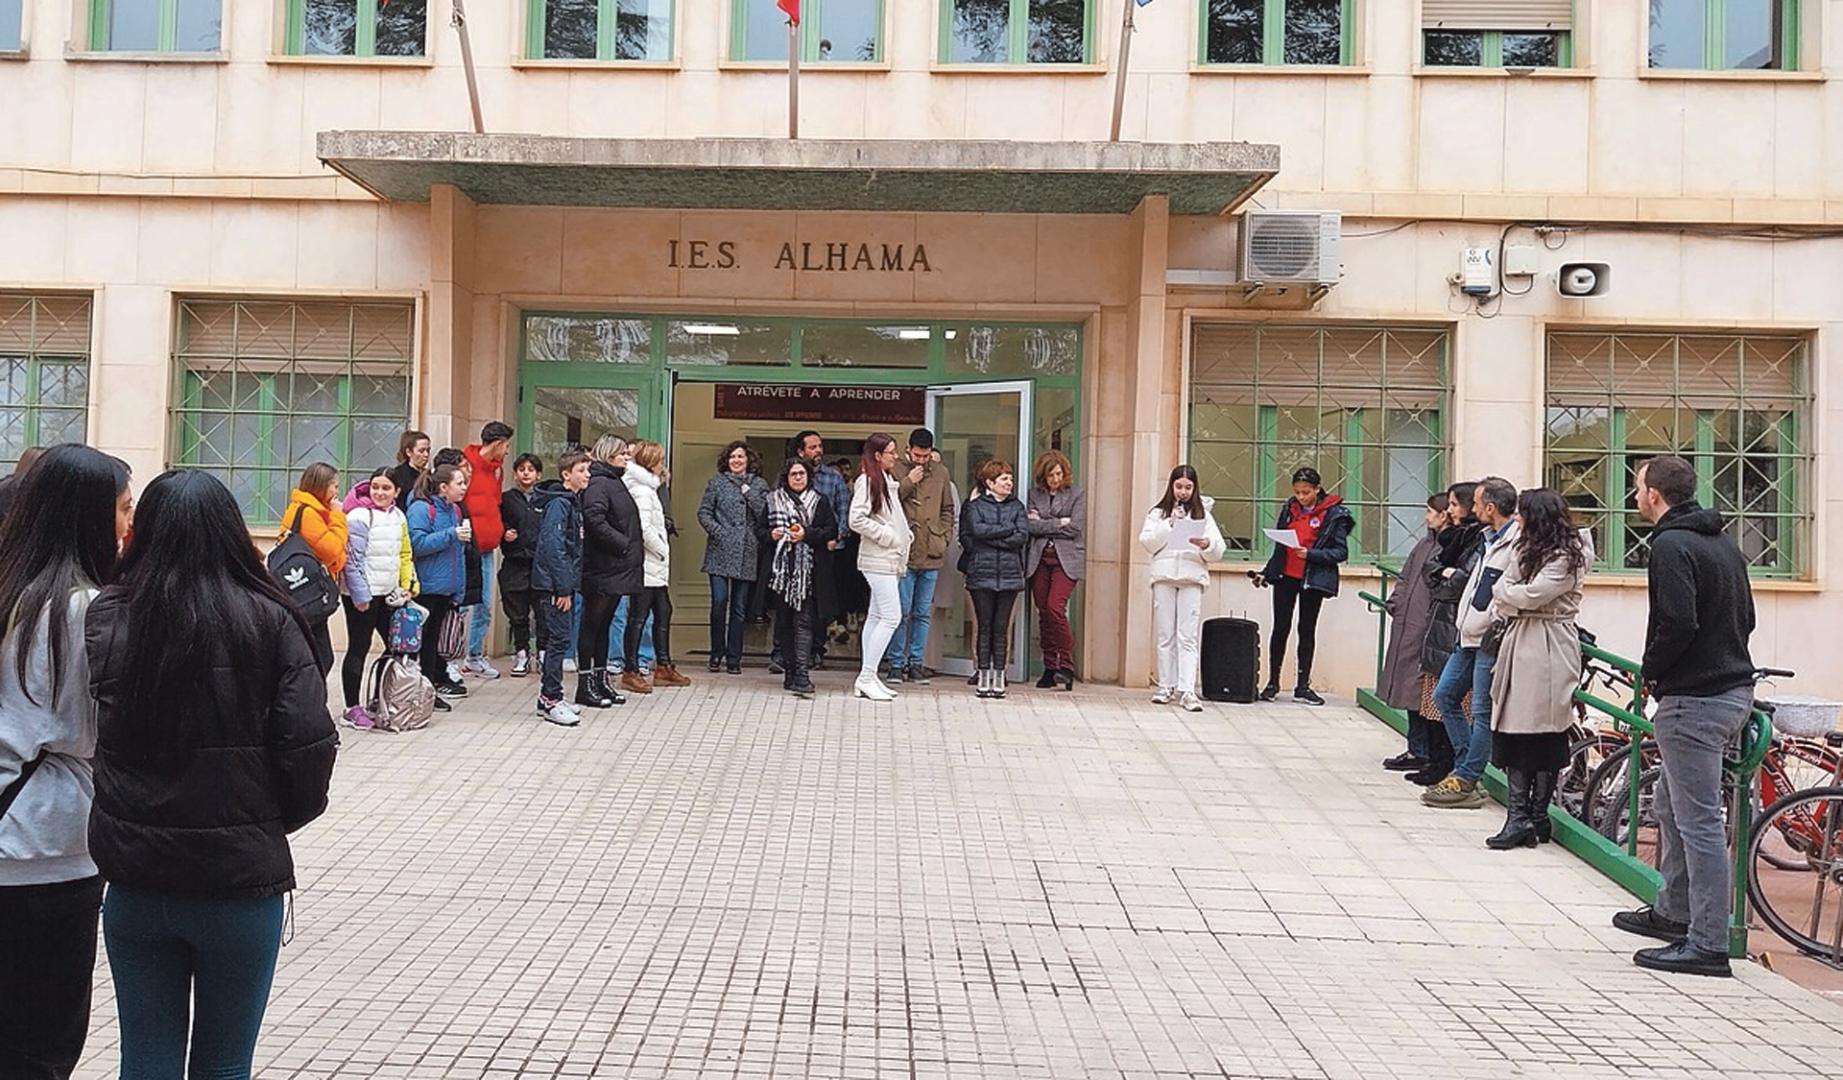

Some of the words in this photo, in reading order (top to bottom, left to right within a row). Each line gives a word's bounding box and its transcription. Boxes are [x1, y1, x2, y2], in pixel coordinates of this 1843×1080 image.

[668, 240, 741, 269] I.E.S.
[774, 242, 932, 272] ALHAMA
[737, 385, 802, 398] ATRÉVETE
[810, 388, 820, 398] A
[828, 388, 901, 401] APRENDER
